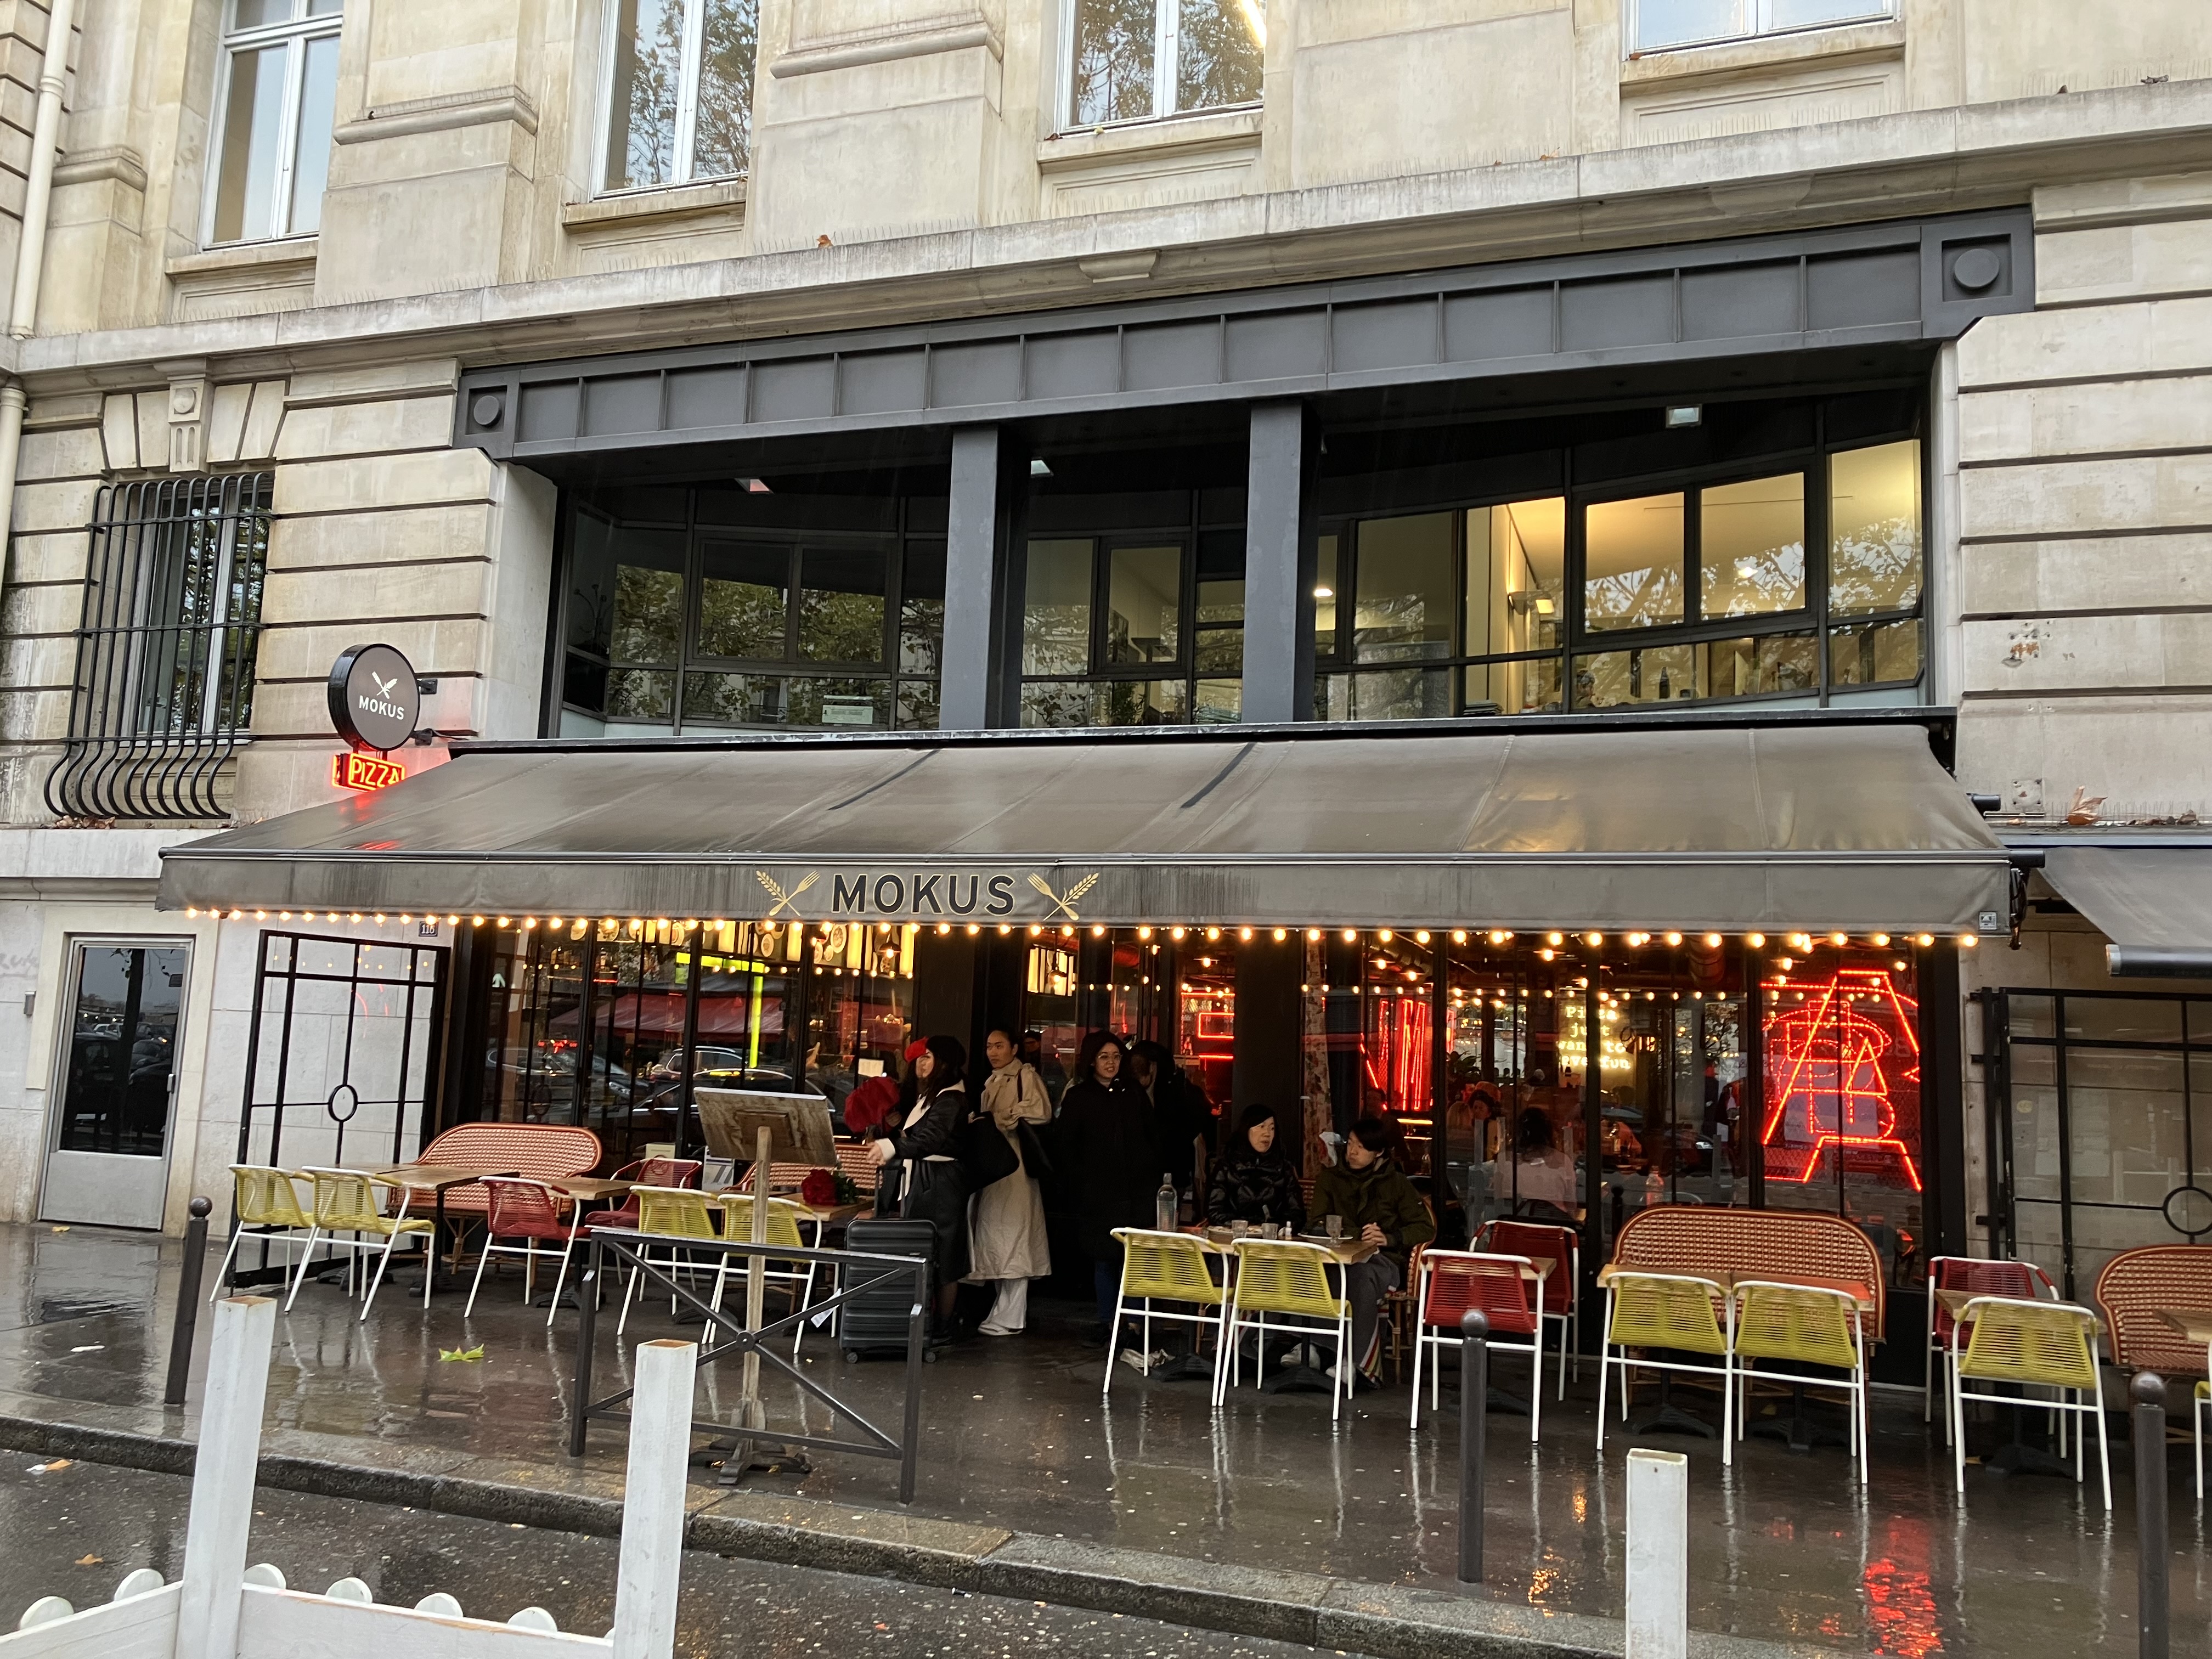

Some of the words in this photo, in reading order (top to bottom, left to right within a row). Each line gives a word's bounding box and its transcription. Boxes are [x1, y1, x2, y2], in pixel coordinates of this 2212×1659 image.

[359, 695, 404, 720] MOKUS
[351, 758, 400, 787] PIZZA
[831, 873, 1016, 916] MOKUS
[421, 924, 435, 934] 116
[1570, 1022, 1610, 1037] jut
[1599, 1056, 1632, 1069] fun
